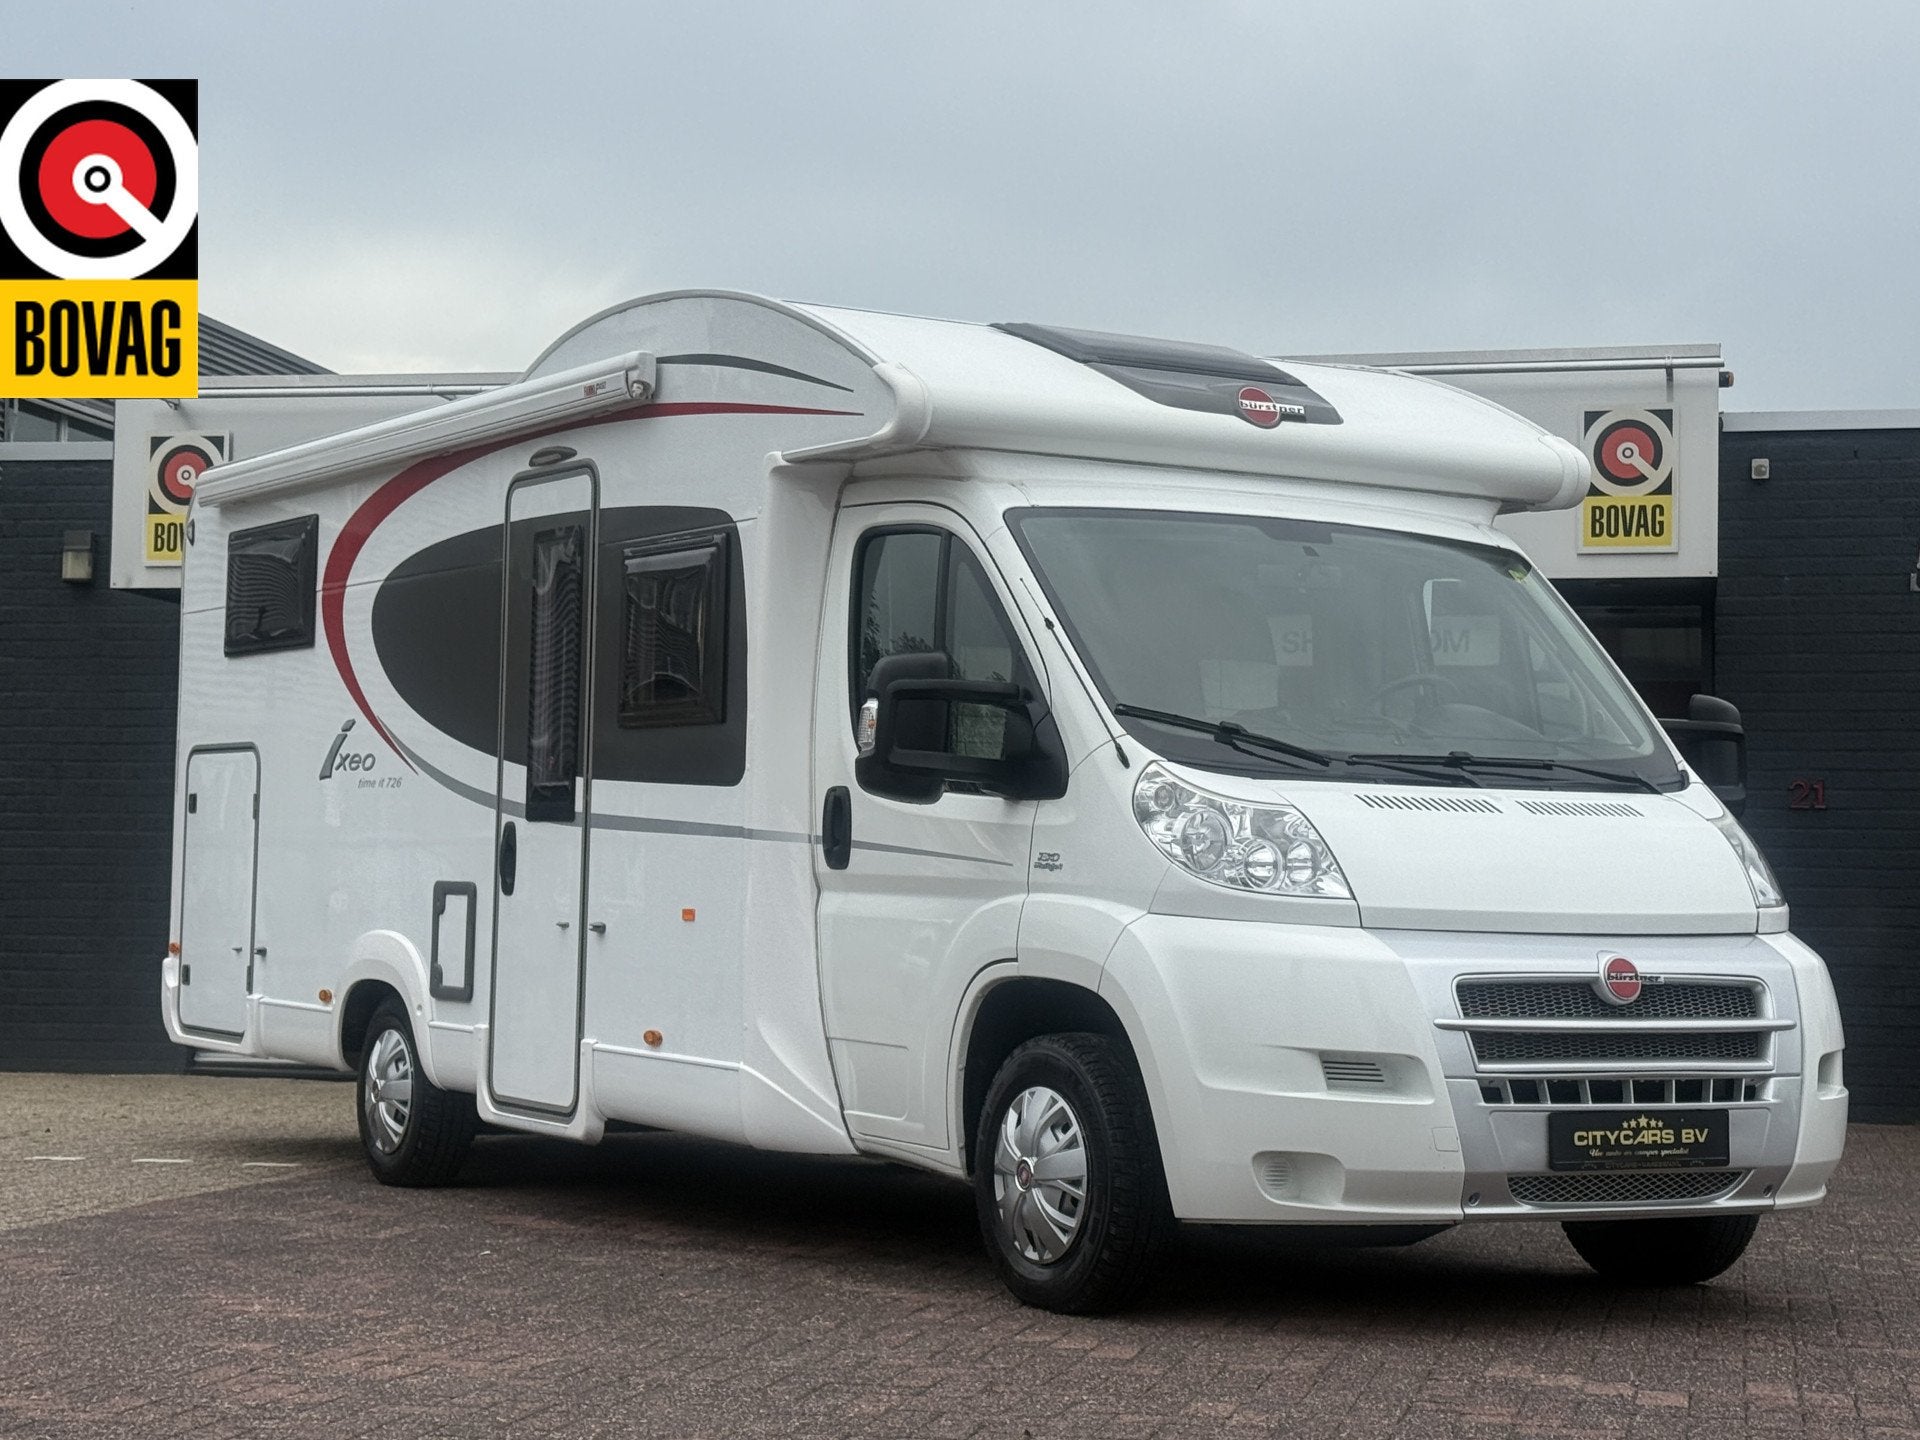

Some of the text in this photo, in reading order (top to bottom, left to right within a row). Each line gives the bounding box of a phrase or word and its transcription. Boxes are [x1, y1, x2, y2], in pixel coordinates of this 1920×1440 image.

[1591, 504, 1664, 538] BOVAG
[386, 776, 403, 789] 726
[1789, 779, 1826, 809] 21
[1573, 1128, 1709, 1147] CITYCARS BV
